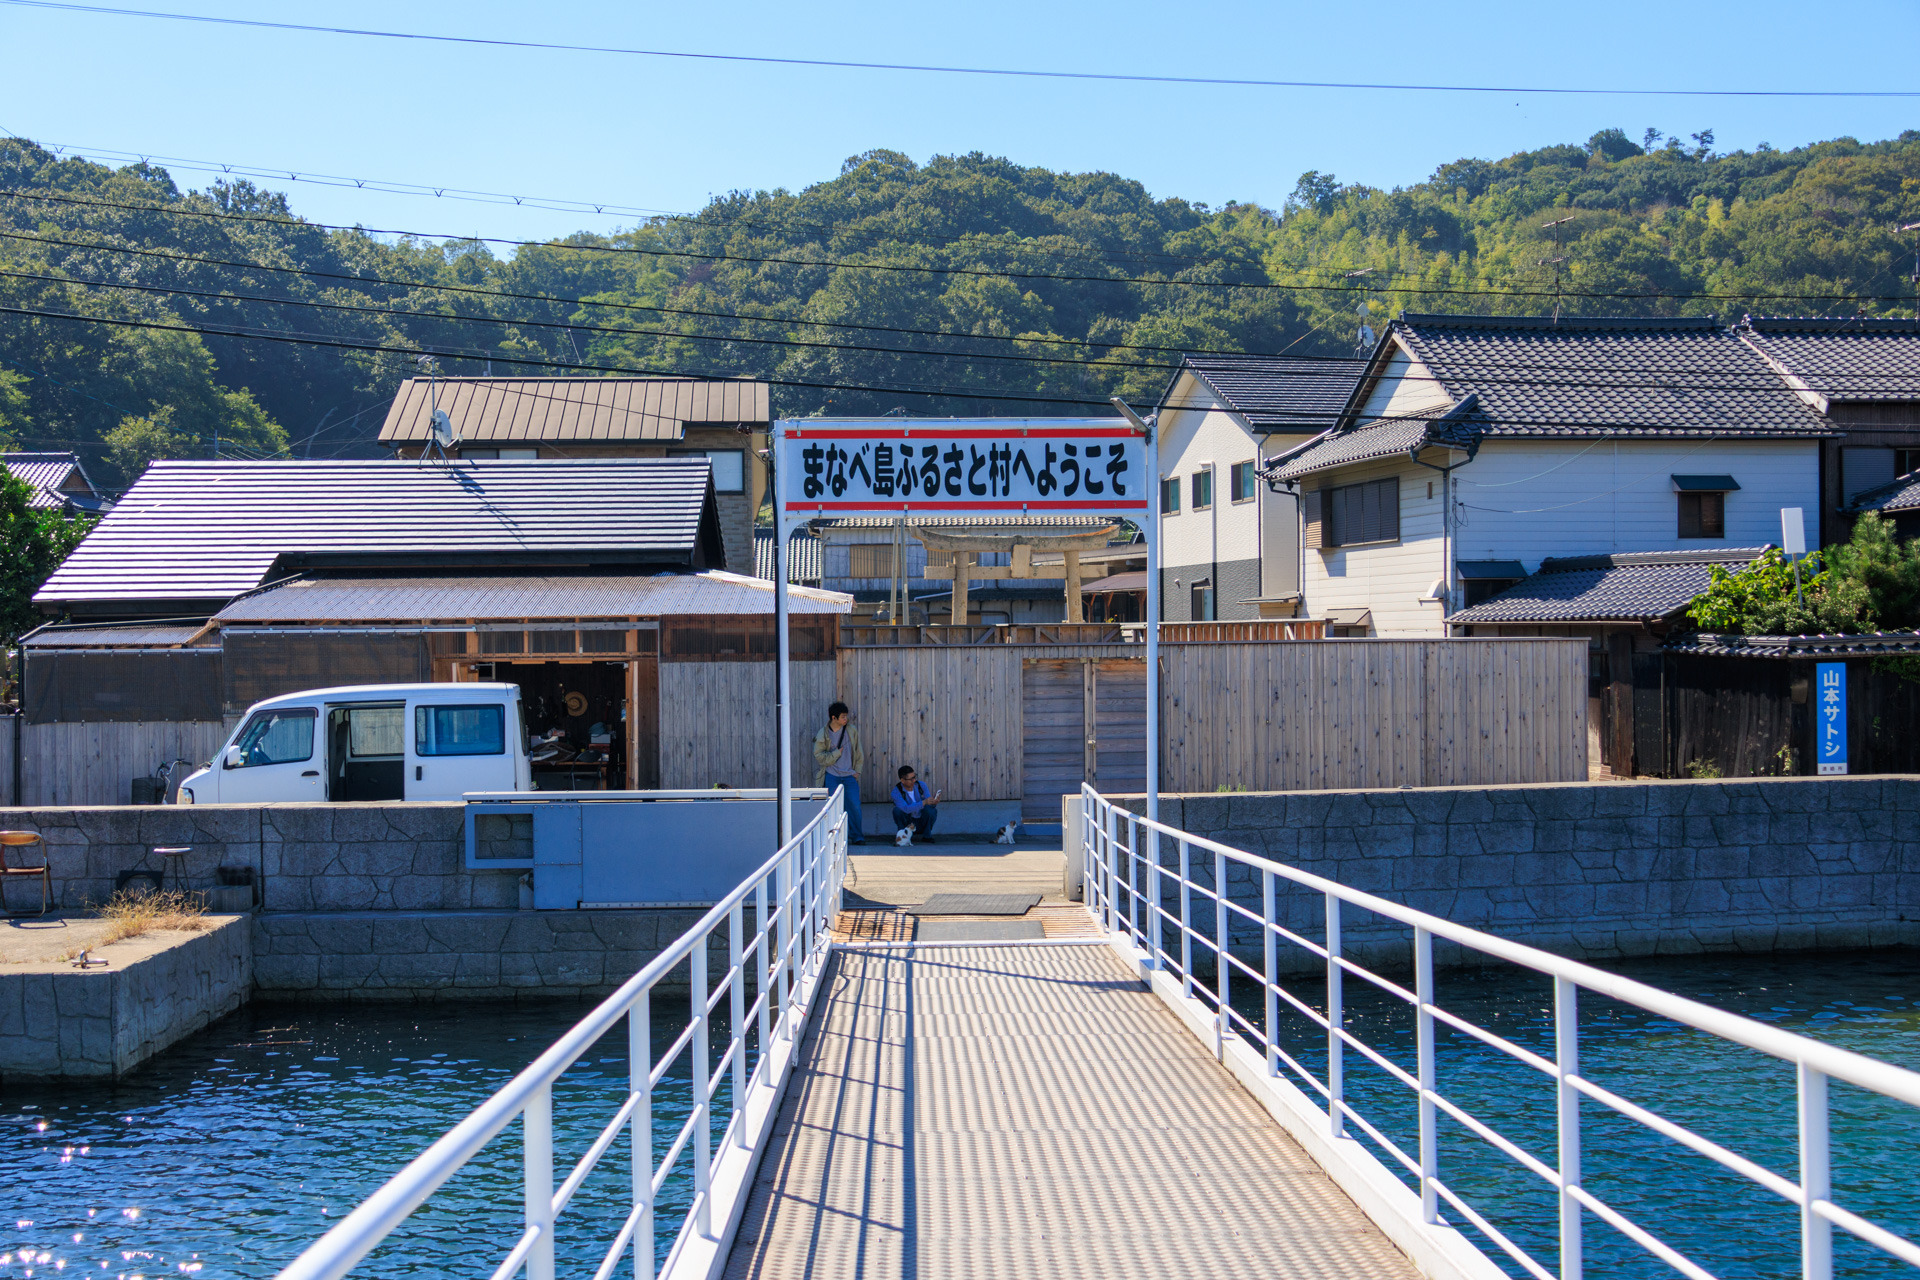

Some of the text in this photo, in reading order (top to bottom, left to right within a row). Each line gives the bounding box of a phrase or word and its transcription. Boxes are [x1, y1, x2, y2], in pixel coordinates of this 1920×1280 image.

[803, 442, 1128, 498] まなべ島ふるさと村へようこそ
[1823, 670, 1840, 757] 山本サトシ
